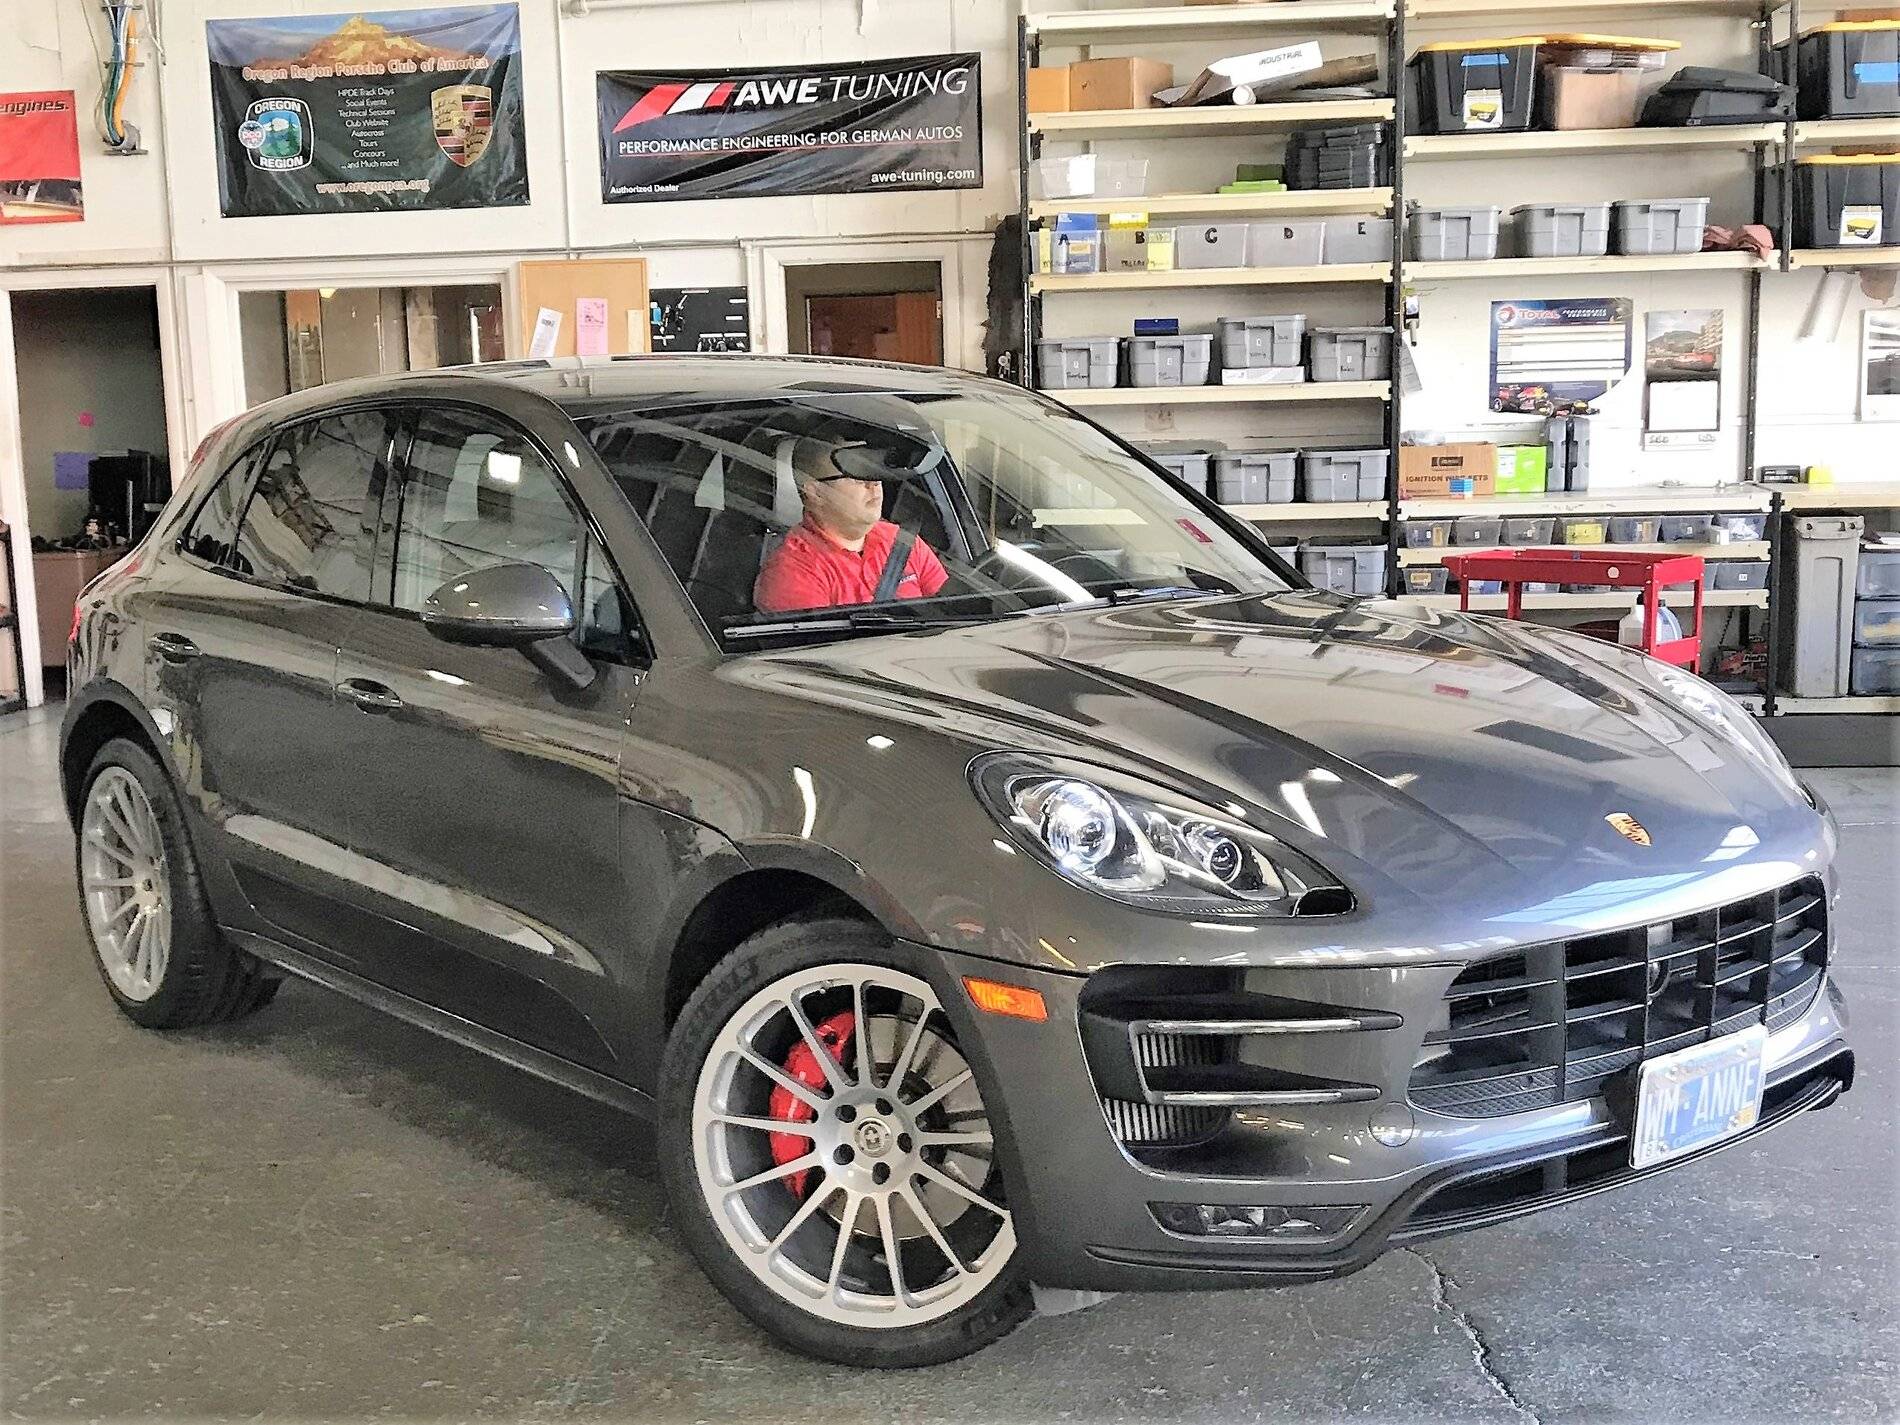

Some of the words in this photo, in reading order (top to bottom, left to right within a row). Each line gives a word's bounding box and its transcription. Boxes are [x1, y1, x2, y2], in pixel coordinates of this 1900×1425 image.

[242, 67, 288, 83] Oregon
[290, 65, 332, 81] Region
[335, 61, 385, 77] Porsche
[388, 58, 417, 74] Club
[420, 59, 435, 73] of
[436, 55, 489, 71] America
[377, 87, 395, 97] Days
[733, 79, 819, 107] AWE
[829, 67, 969, 101] TUNING
[254, 101, 302, 114] OREGON
[619, 137, 719, 155] PERFORMANCE
[722, 132, 816, 150] ENGINEERING
[820, 131, 849, 145] FOR
[851, 128, 912, 143] GERMAN
[915, 126, 963, 141] AUTOS
[353, 149, 386, 158] Concours
[260, 156, 304, 168] REGION
[360, 160, 379, 168] Much
[871, 168, 975, 185] awe-tuning.com
[316, 179, 430, 195] www.oregonpca.org
[610, 184, 653, 194] Authorized
[653, 183, 680, 192] Dealer
[1283, 227, 1294, 239] D
[1357, 222, 1366, 235] E
[1058, 234, 1070, 245] A
[1135, 231, 1145, 244] B
[1520, 309, 1560, 320] TOTAL
[1406, 475, 1443, 483] IGNITION
